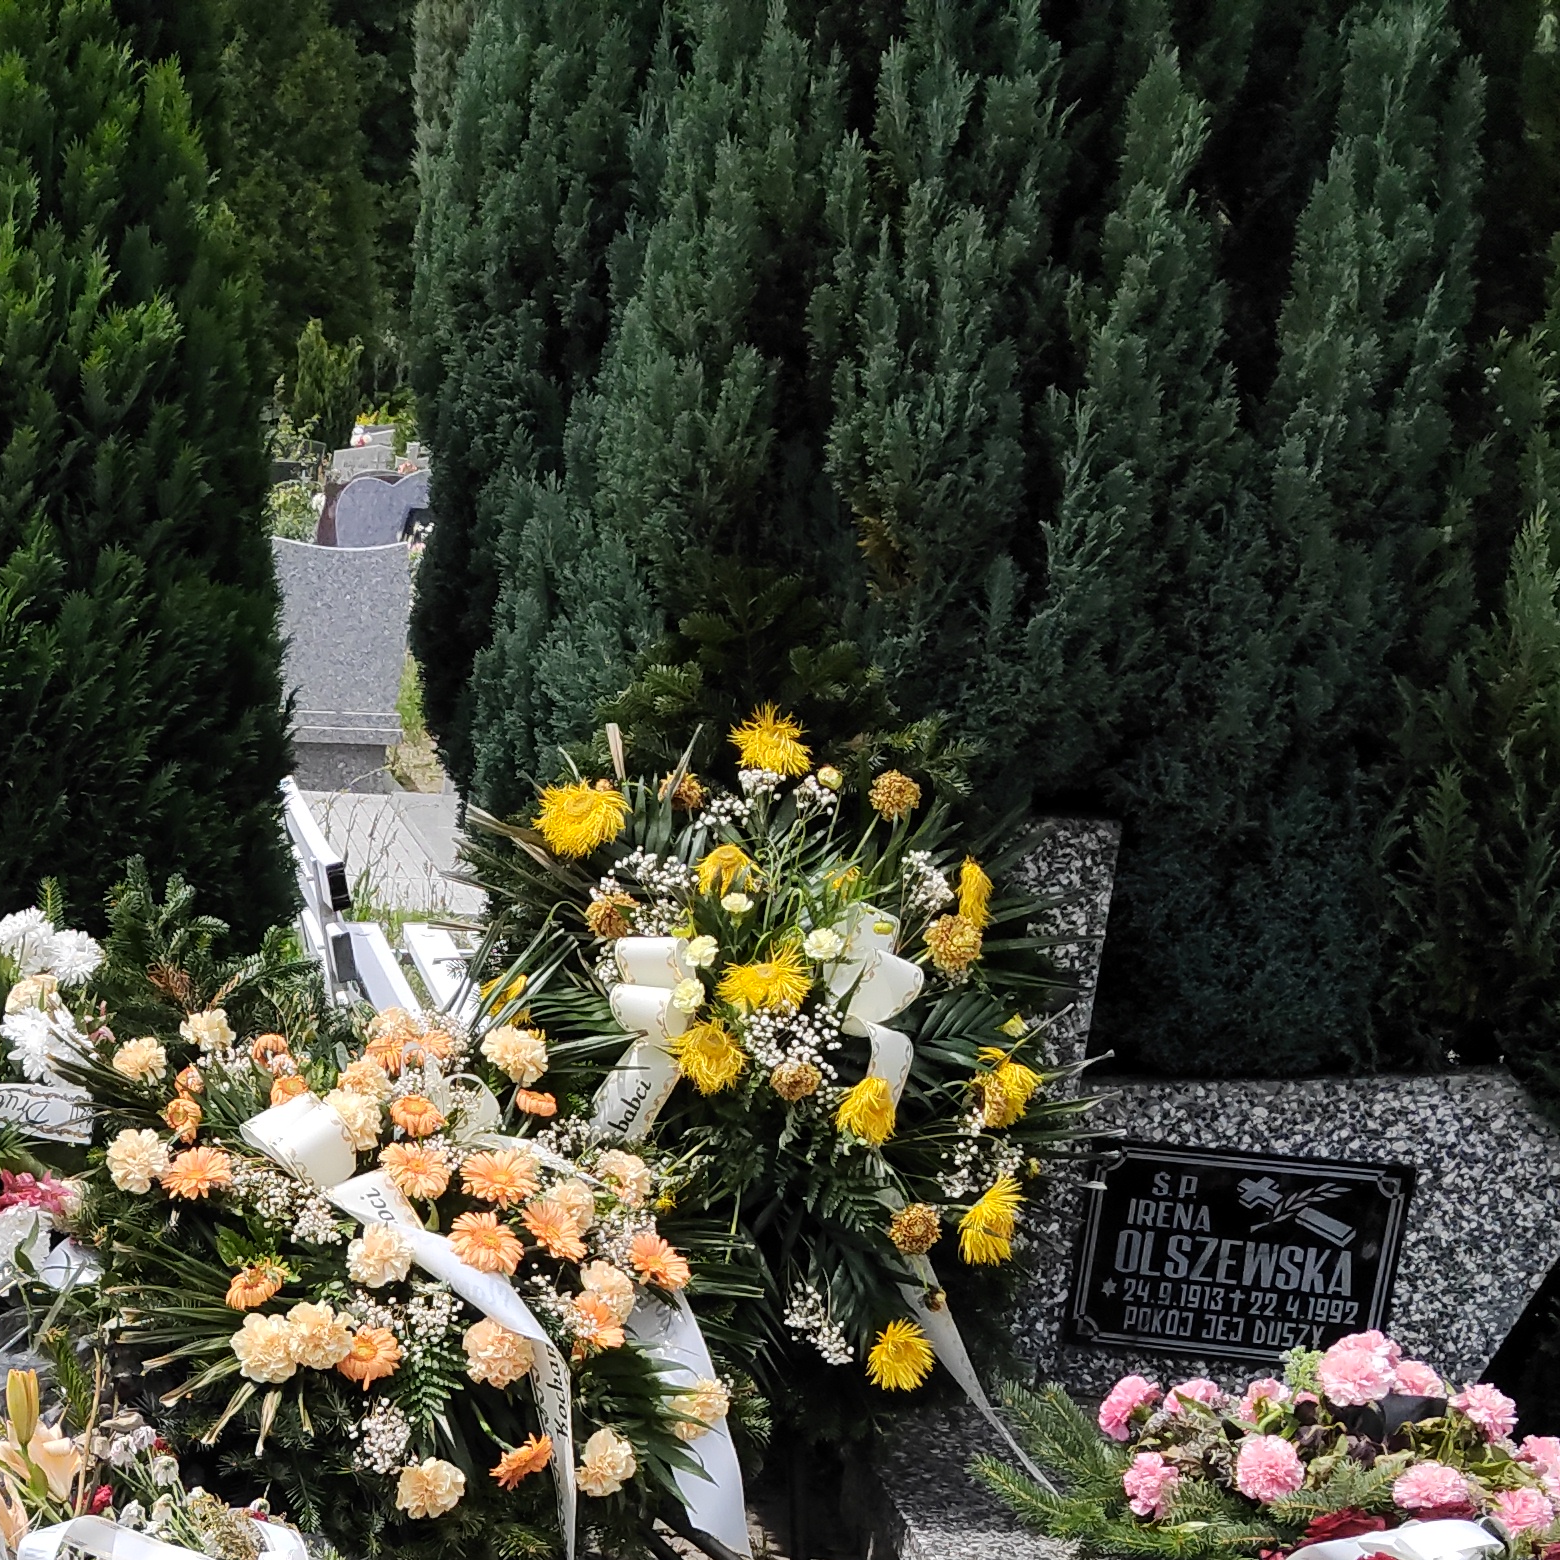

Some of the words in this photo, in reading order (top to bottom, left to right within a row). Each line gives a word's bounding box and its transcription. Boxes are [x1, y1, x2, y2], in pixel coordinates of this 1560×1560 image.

[1126, 1198, 1211, 1233] IRENA
[1114, 1229, 1352, 1297] OLSZEWSKA
[1123, 1278, 1224, 1311] 24.9.1913
[1248, 1291, 1359, 1325] 22.4.1992
[1201, 1313, 1245, 1342] JEJ
[1252, 1320, 1325, 1350] DUSZY
[545, 1343, 570, 1444] Kochan
